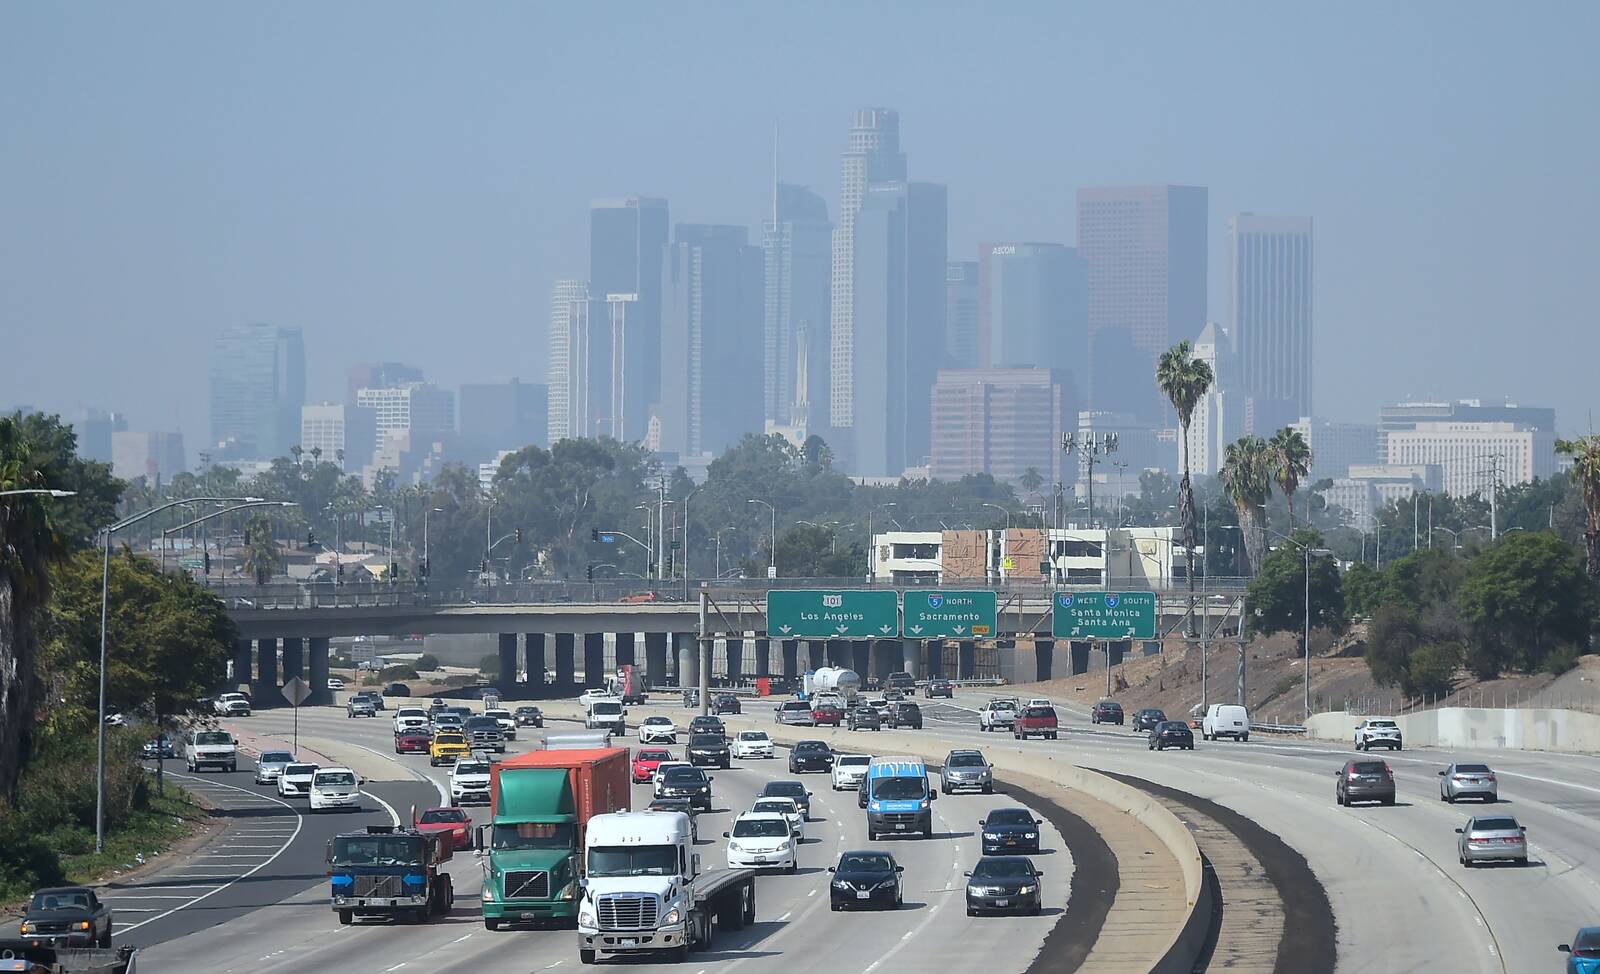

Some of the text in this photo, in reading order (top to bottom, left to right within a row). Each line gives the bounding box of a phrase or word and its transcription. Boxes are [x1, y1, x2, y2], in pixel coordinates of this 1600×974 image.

[992, 245, 1015, 254] AECOM
[800, 612, 864, 622] Los Angeles
[919, 612, 980, 621] Sacramento
[1071, 608, 1140, 617] Santa Monica
[1078, 618, 1107, 626] Santa
